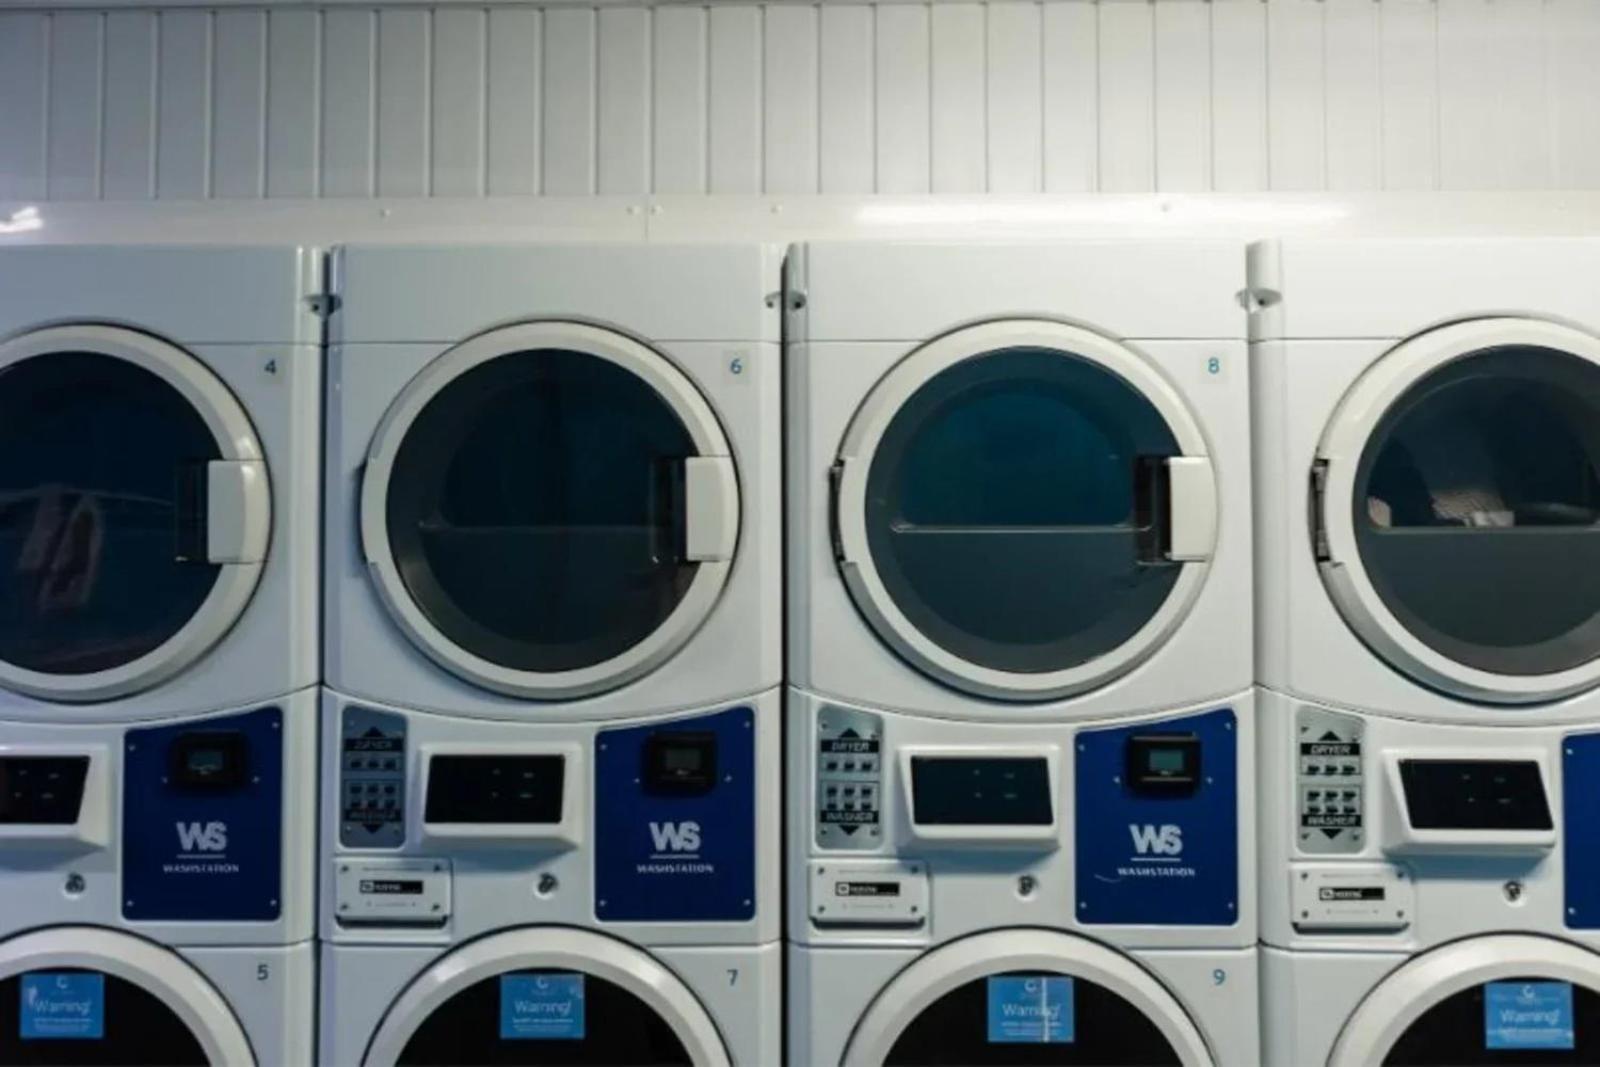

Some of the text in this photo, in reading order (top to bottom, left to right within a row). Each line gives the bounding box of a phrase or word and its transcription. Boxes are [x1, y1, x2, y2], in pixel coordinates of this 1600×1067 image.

[264, 358, 277, 374] 4
[730, 358, 742, 375] 6
[1208, 357, 1220, 375] 8
[831, 741, 870, 753] DRYER
[1310, 744, 1352, 756] DRYER
[826, 811, 874, 822] WASHER
[1308, 815, 1356, 826] WASHER
[176, 821, 227, 852] WS
[649, 821, 702, 852] WS
[1129, 824, 1183, 855] WS
[163, 864, 240, 874] WASHSTATION
[636, 864, 715, 874] WASHSTATION
[1117, 867, 1196, 878] WASHSTATION
[256, 964, 269, 982] 5
[726, 968, 739, 986] 7
[1213, 968, 1226, 987] 9
